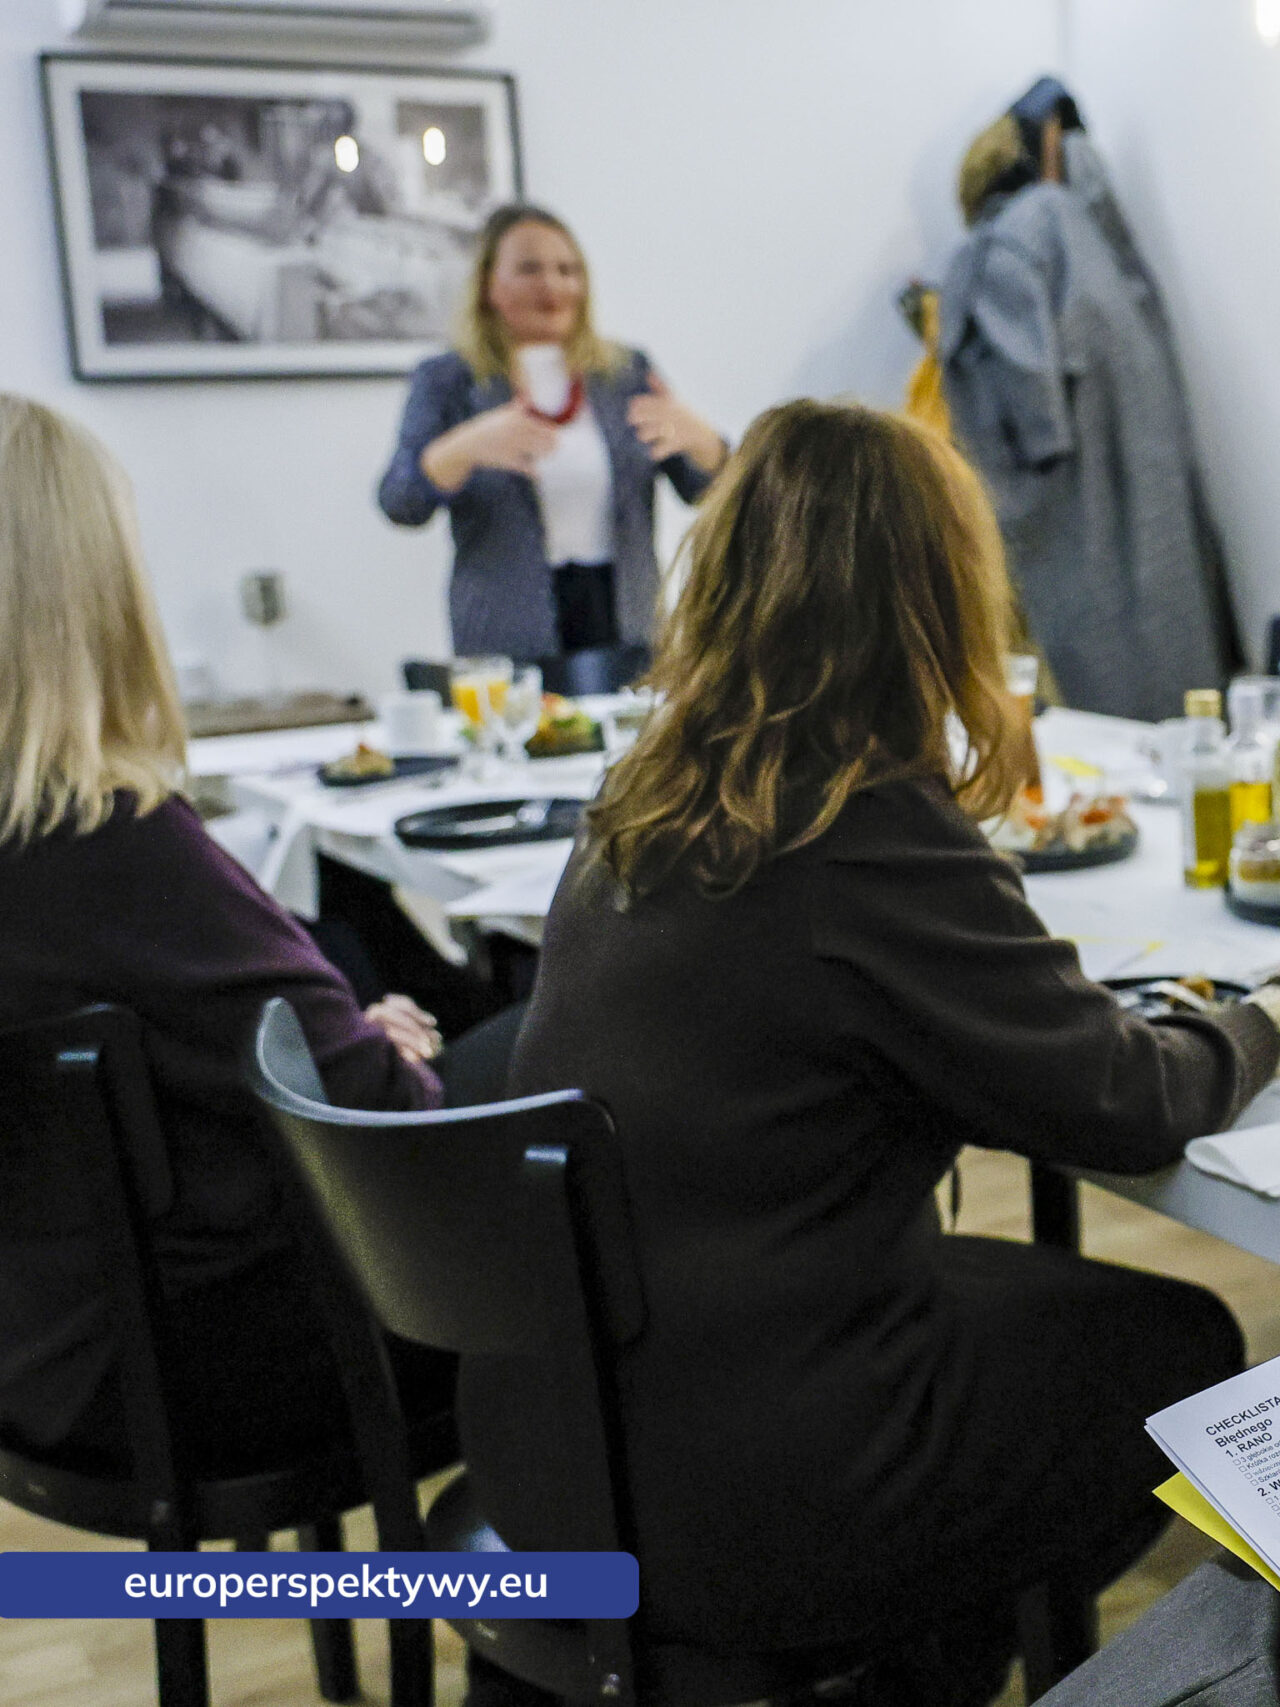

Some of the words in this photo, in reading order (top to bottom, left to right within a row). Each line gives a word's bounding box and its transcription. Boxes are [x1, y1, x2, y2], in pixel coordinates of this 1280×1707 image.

[1214, 1418, 1273, 1448] Błędnego
[1225, 1449, 1238, 1458] 1.
[1236, 1431, 1273, 1453] RANO
[1256, 1487, 1271, 1497] 2.
